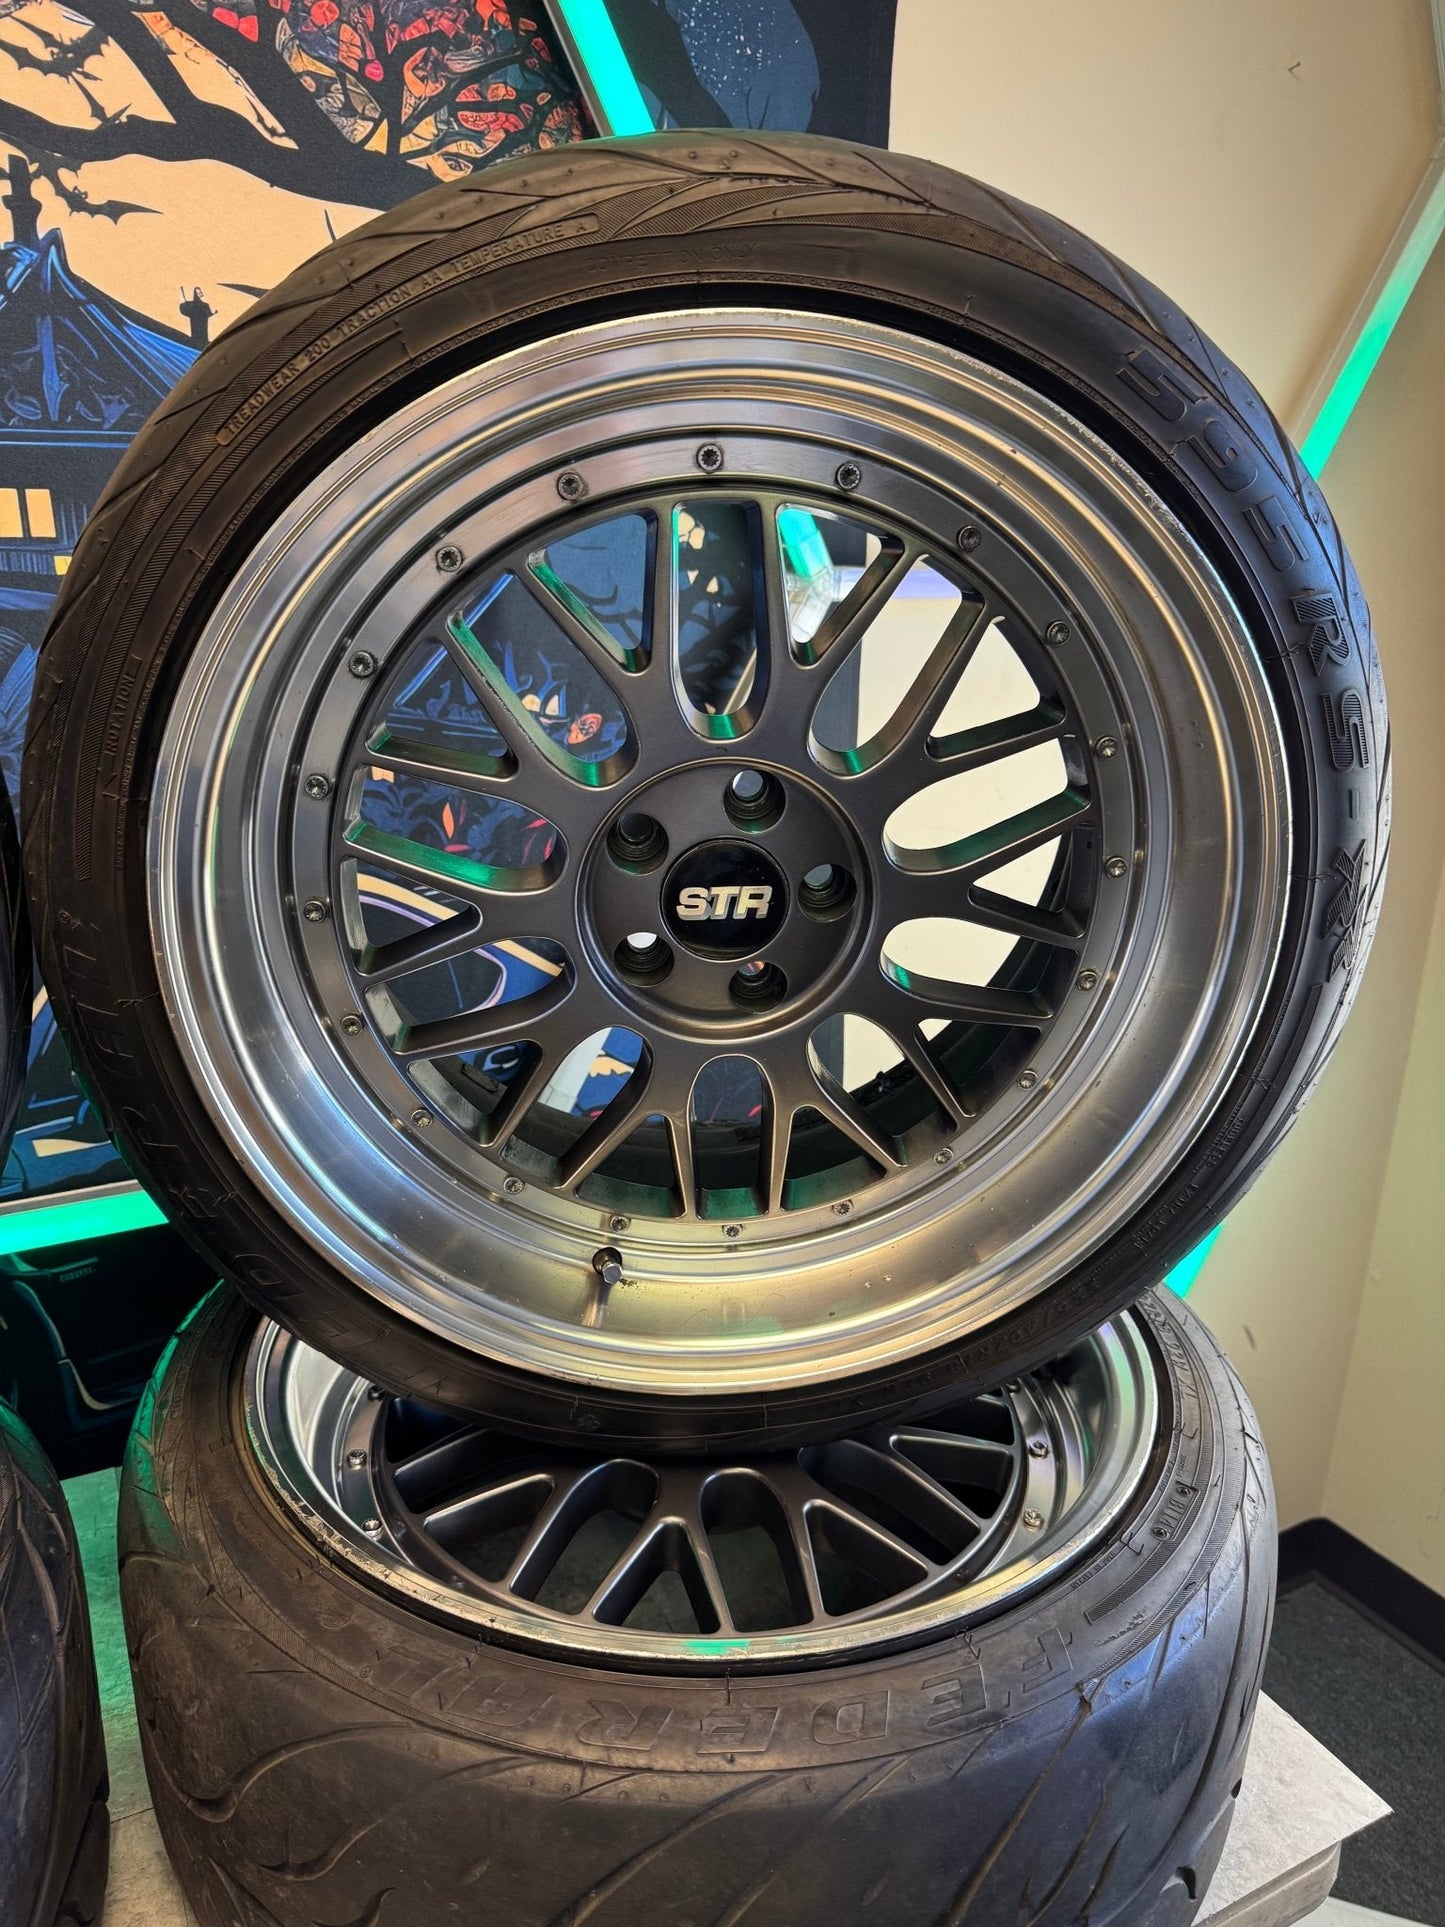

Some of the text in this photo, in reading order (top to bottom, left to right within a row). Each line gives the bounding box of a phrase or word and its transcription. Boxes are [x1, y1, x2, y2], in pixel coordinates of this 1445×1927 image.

[711, 243, 761, 262] ONLY
[225, 361, 301, 436] TREADWEAR
[303, 337, 332, 365] 200
[336, 284, 412, 337] TRACTION
[419, 270, 444, 291] AA
[449, 224, 564, 273] TEMPERATURE
[575, 221, 588, 234] A
[104, 675, 136, 757] ROTATION
[675, 885, 773, 921] STR
[368, 1626, 1073, 1755] FEDERAL
